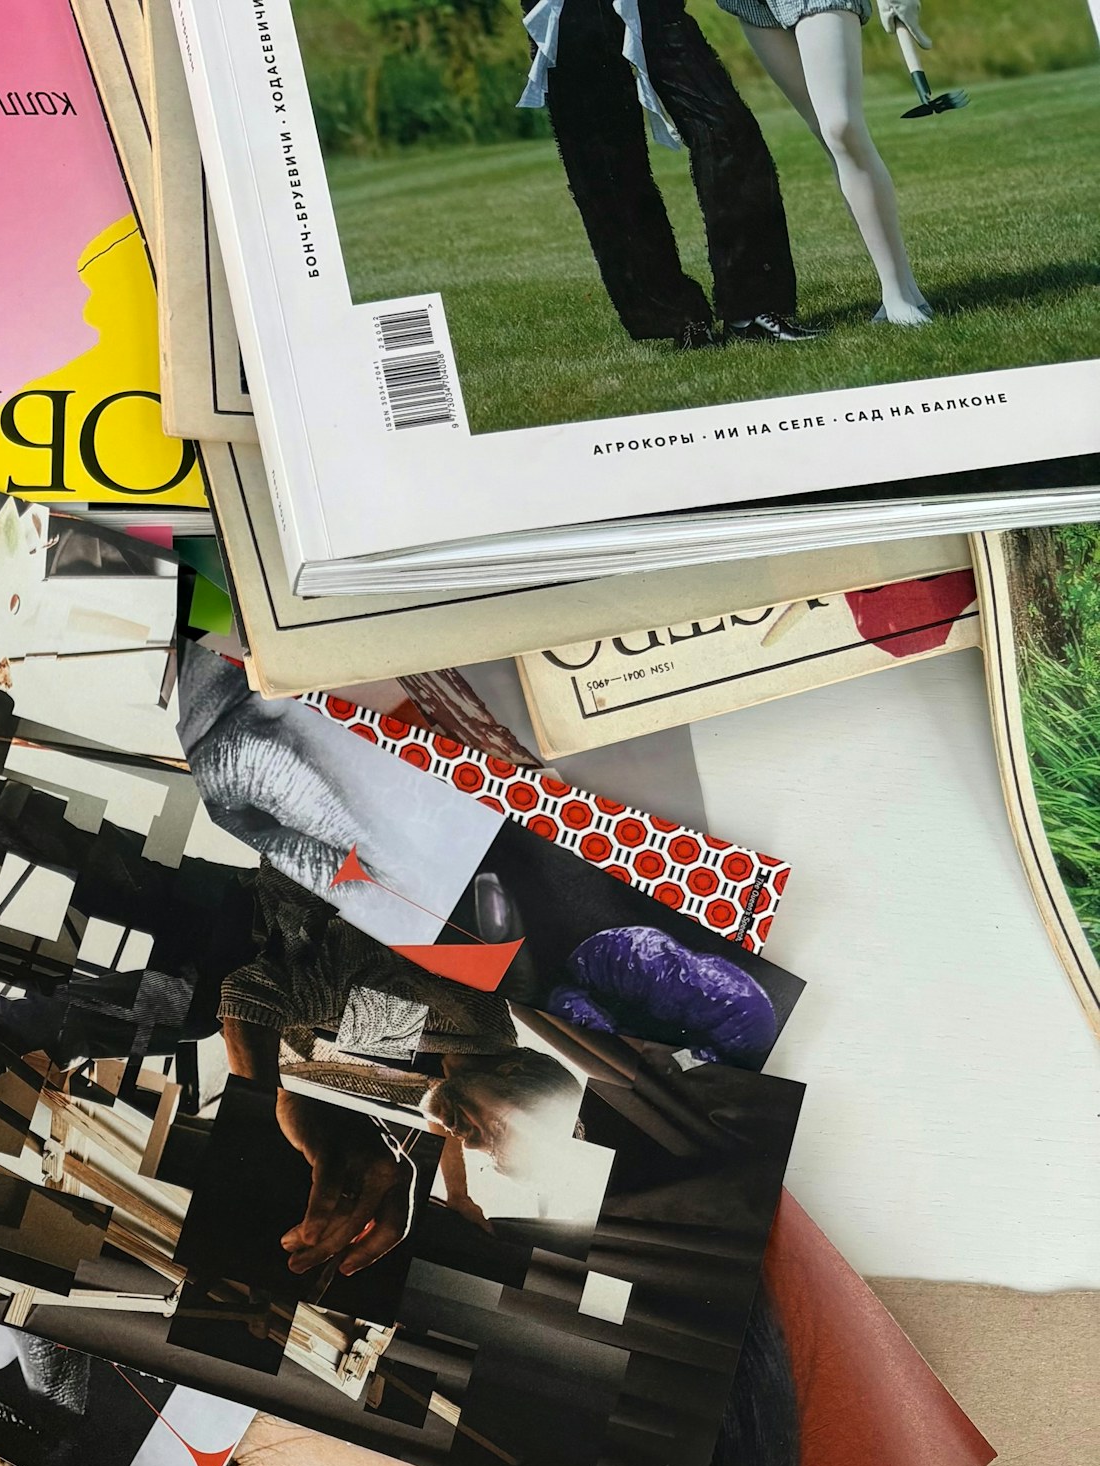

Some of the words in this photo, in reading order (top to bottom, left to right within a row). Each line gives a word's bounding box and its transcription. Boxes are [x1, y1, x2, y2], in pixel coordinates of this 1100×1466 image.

[280, 131, 320, 278] БОНЧ-БРУЕВИЧИ
[372, 316, 385, 349] 25002
[373, 360, 388, 406] 3034-7041
[384, 410, 393, 431] ISSN
[592, 432, 696, 456] АГРОКОРЫ
[713, 426, 740, 441] ИИ
[746, 422, 772, 437] НА
[778, 415, 826, 431] СЕЛЕ
[843, 408, 884, 424] САД
[890, 404, 915, 418] НА
[921, 392, 1008, 414] БАЛКОНЕ
[649, 661, 674, 675] ISSN
